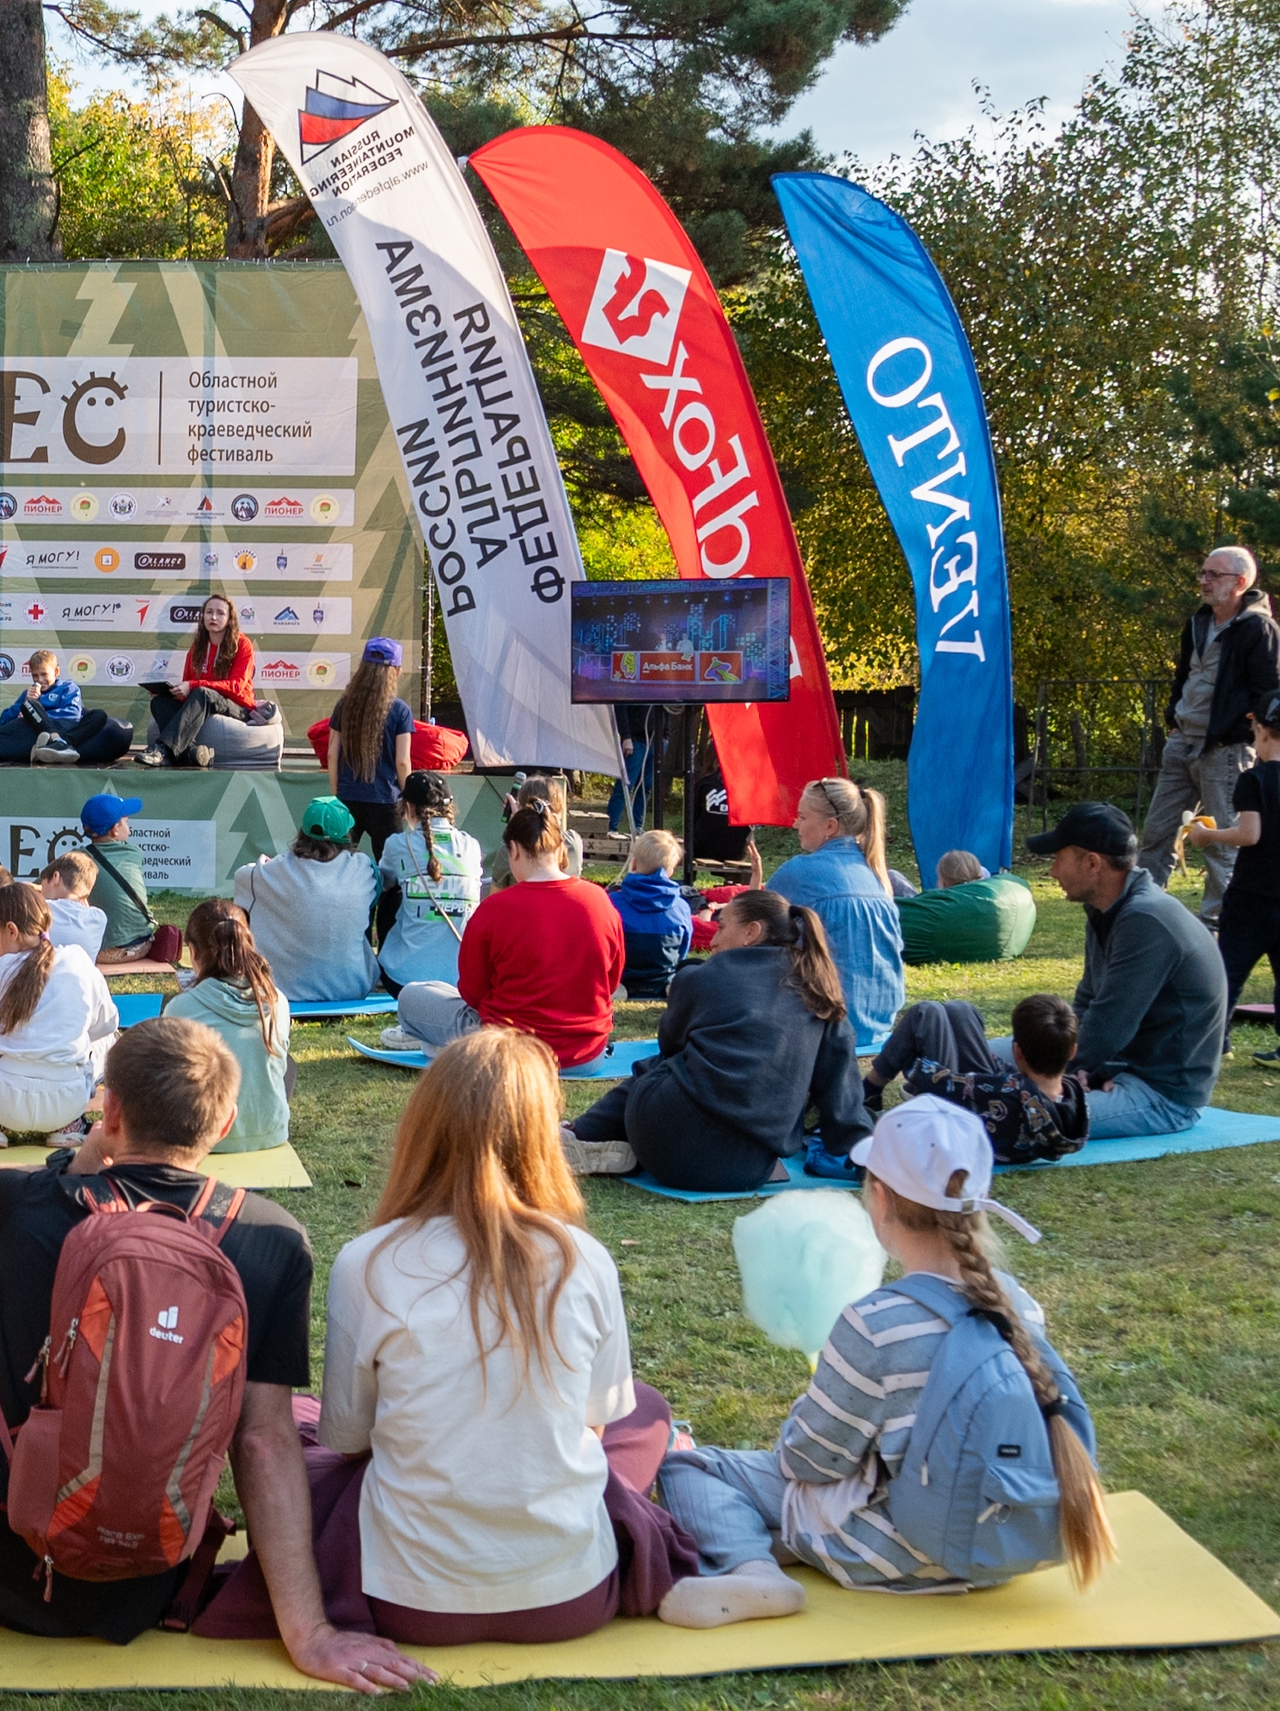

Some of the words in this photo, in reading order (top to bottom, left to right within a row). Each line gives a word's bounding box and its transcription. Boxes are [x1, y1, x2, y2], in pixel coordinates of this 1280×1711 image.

[189, 371, 278, 390] Областной
[188, 397, 276, 417] туристско-
[188, 421, 312, 441] краеведческий
[187, 444, 274, 464] фестиваль
[24, 504, 62, 513] ПИОНЕР
[264, 506, 304, 515] ПИОНЕР
[26, 554, 35, 565] Я
[38, 550, 80, 565] МОГУ!
[62, 607, 71, 618] Я
[74, 603, 116, 617] МОГУ!
[642, 661, 670, 673] Альфа
[671, 661, 693, 671] Банк
[261, 670, 301, 679] ПИОНЕР
[128, 826, 171, 838] бластной
[139, 843, 170, 852] стско-
[142, 855, 192, 867] ведческий
[144, 870, 169, 880] иваль
[149, 1325, 184, 1344] deuter
